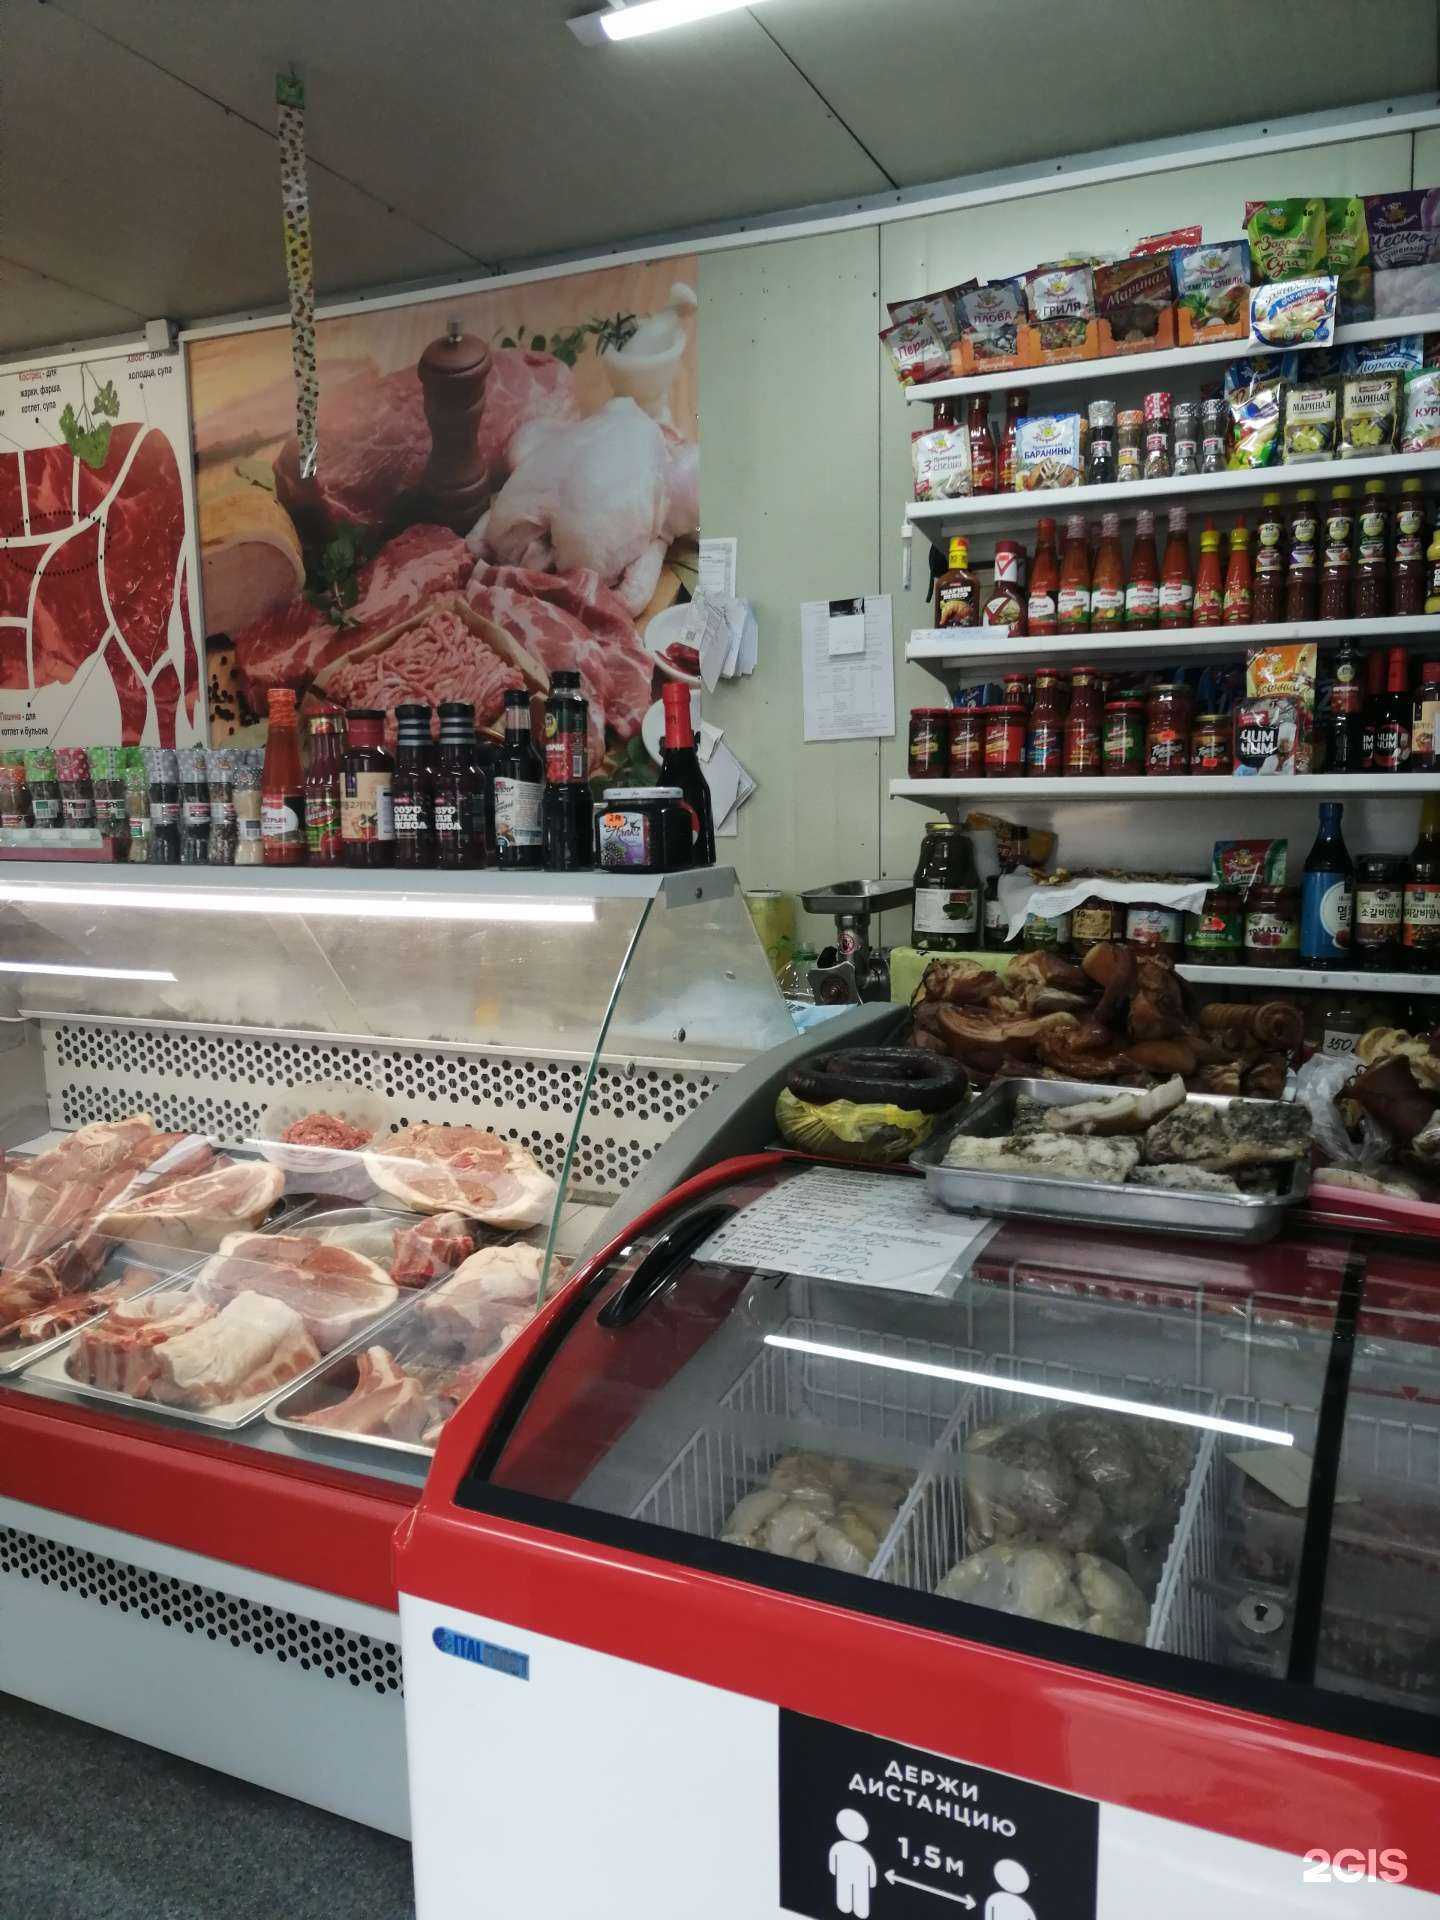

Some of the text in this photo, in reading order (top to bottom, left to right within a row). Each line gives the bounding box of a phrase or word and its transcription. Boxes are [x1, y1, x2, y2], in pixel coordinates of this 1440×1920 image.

[1043, 304, 1082, 317] ГРИЛЯ
[974, 311, 1013, 324] ПЛОВА
[1292, 400, 1332, 411] МАРИНАД
[1024, 448, 1072, 460] БАРАНИНЫ
[1248, 927, 1288, 936] ТОМАТЫ
[884, 1760, 978, 1802] ДЕРЖИ
[848, 1773, 1017, 1838] ДИСТАНЦИЮ
